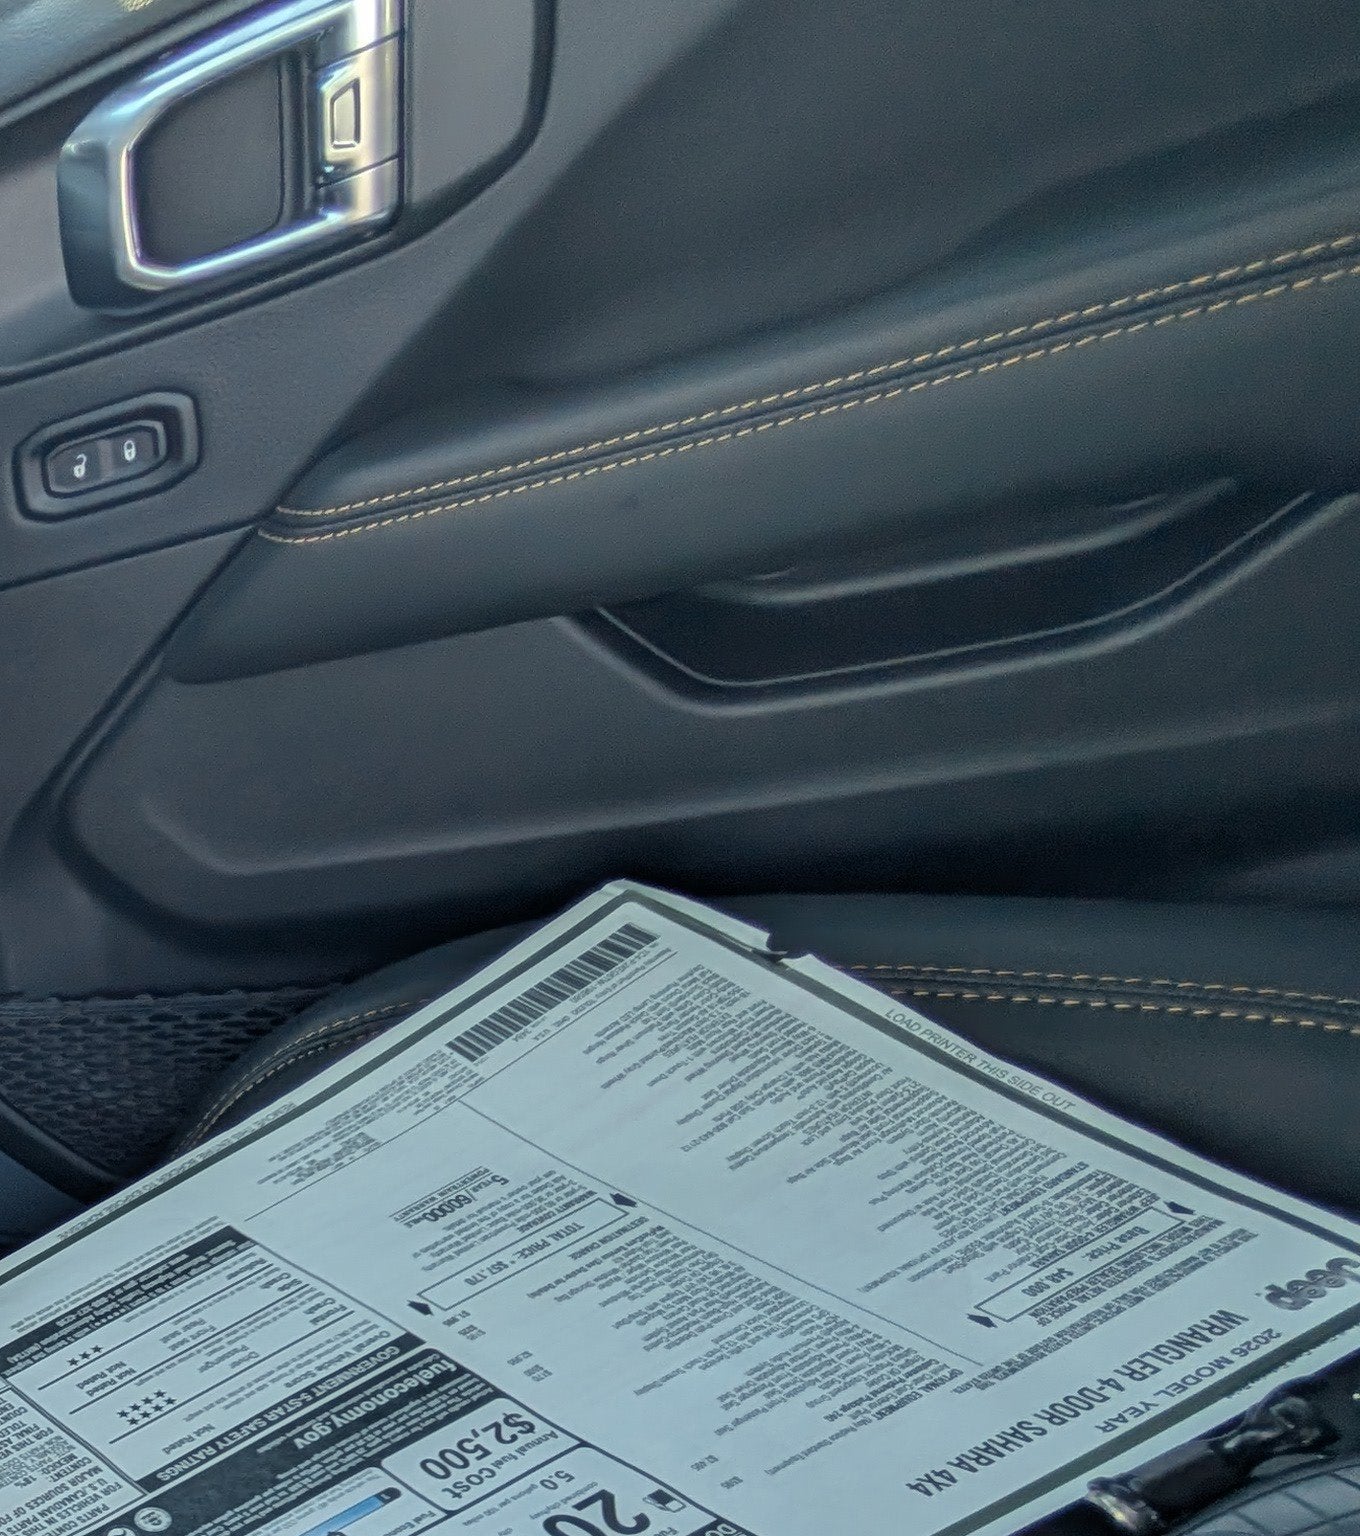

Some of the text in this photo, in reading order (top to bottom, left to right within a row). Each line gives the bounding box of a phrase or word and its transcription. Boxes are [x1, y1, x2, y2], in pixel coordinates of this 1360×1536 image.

[885, 1008, 1076, 1110] LOAD PRINTER THIS SIDE OUT
[512, 1238, 551, 1259] PRICE:
[545, 1222, 584, 1241] TOTAL
[225, 1257, 267, 1280] Rollover
[1021, 1226, 1150, 1296] Base Price: $48,000
[197, 1297, 336, 1373] Crash Passenger
[228, 1304, 347, 1369] Frontal Driver
[283, 1330, 391, 1388] Overall Vehicle Score
[310, 1341, 399, 1396] GOVERNMENT
[1094, 1327, 1281, 1433] 2026 MODEL YEAR
[263, 1392, 312, 1421] 5-STAR
[293, 1354, 456, 1449] fueleconomy.gov
[905, 1309, 1249, 1496] WRANGLER 4-DOOR SAHARA 4X4
[161, 1423, 215, 1454] Not Rated
[215, 1417, 267, 1449] SAFETY
[419, 1412, 535, 1479] $2,500
[67, 1465, 103, 1486] MAJOR
[156, 1445, 217, 1480] RATINGS
[441, 1430, 558, 1499] Annual fuel cost
[12, 1506, 26, 1517] OF
[24, 1482, 69, 1510] SOURCES
[75, 1503, 109, 1523] PARTS
